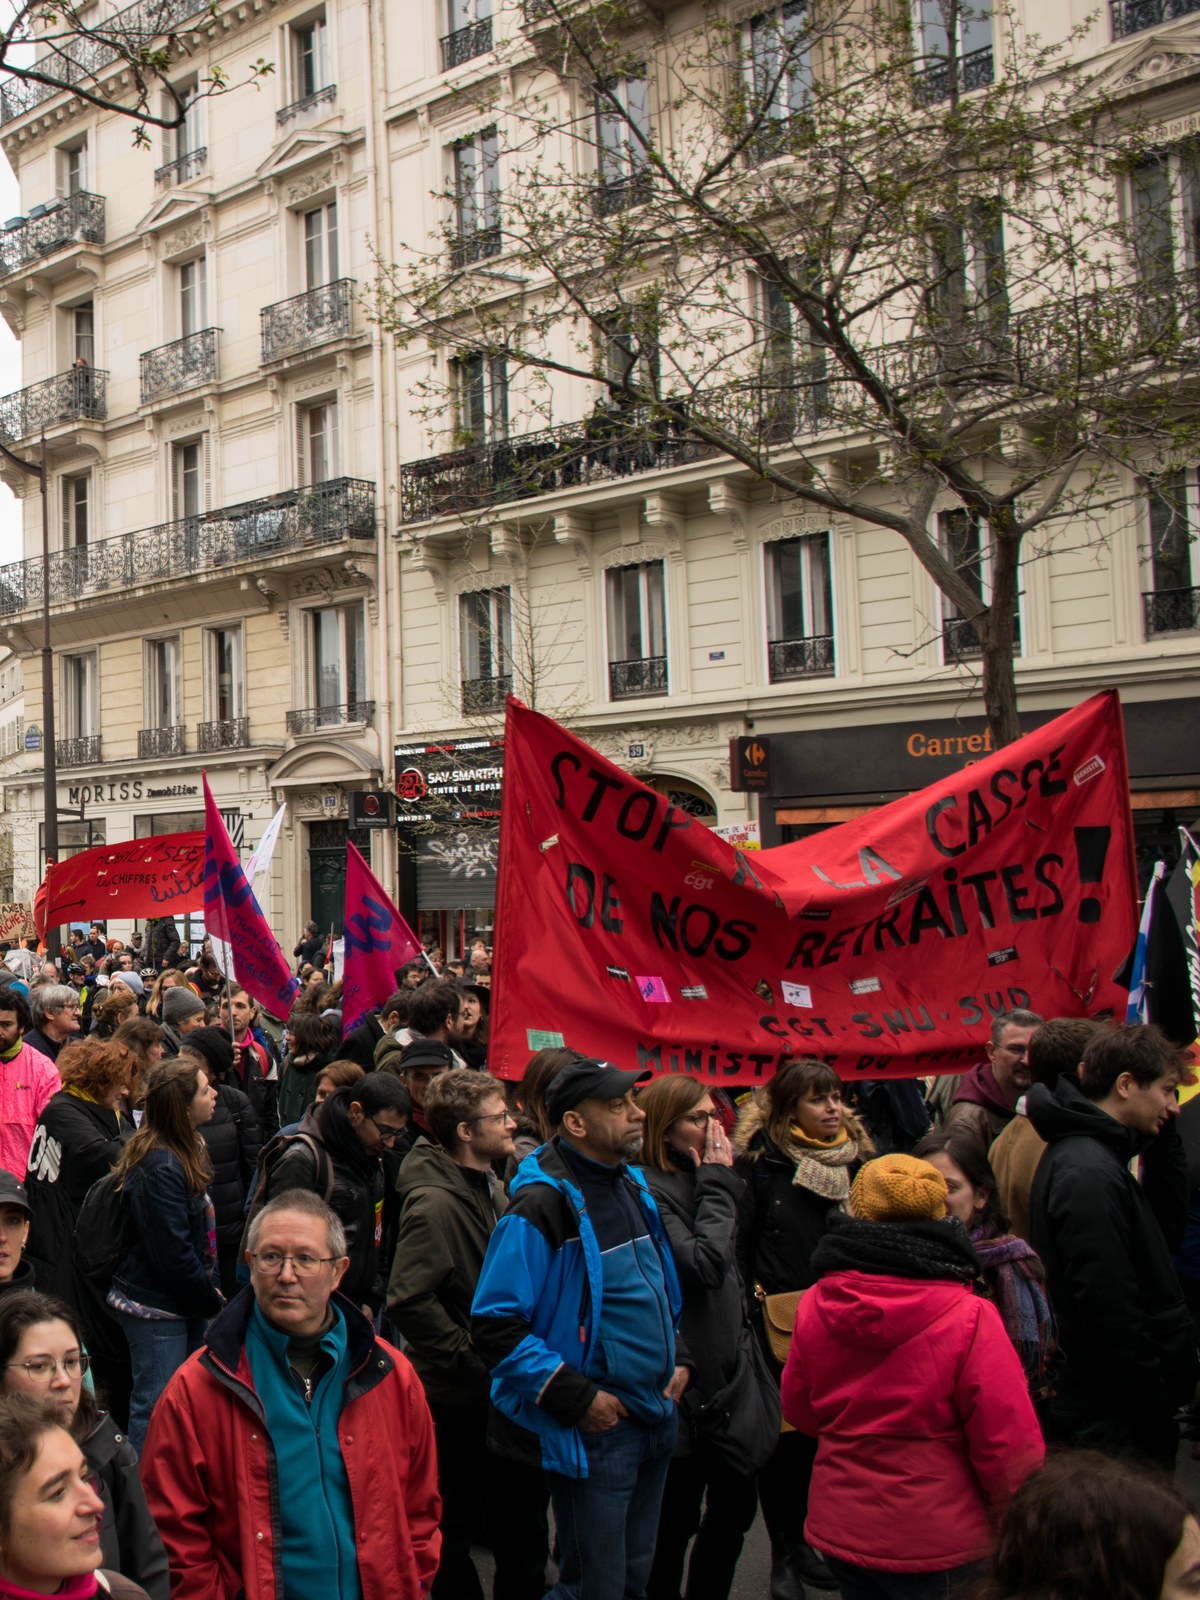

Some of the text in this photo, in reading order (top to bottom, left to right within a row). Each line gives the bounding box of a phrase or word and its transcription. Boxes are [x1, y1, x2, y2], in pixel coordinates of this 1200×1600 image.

[630, 746, 642, 757] 39
[69, 780, 198, 805] MORISS Immobilier
[326, 796, 337, 808] 37
[550, 751, 691, 852] STOP
[810, 845, 904, 890] LA
[684, 875, 715, 890] cgt
[566, 862, 624, 935] DE
[651, 890, 758, 962] NOS
[759, 987, 1031, 1038] CGT SNU SUD
[856, 1055, 893, 1071] DU
